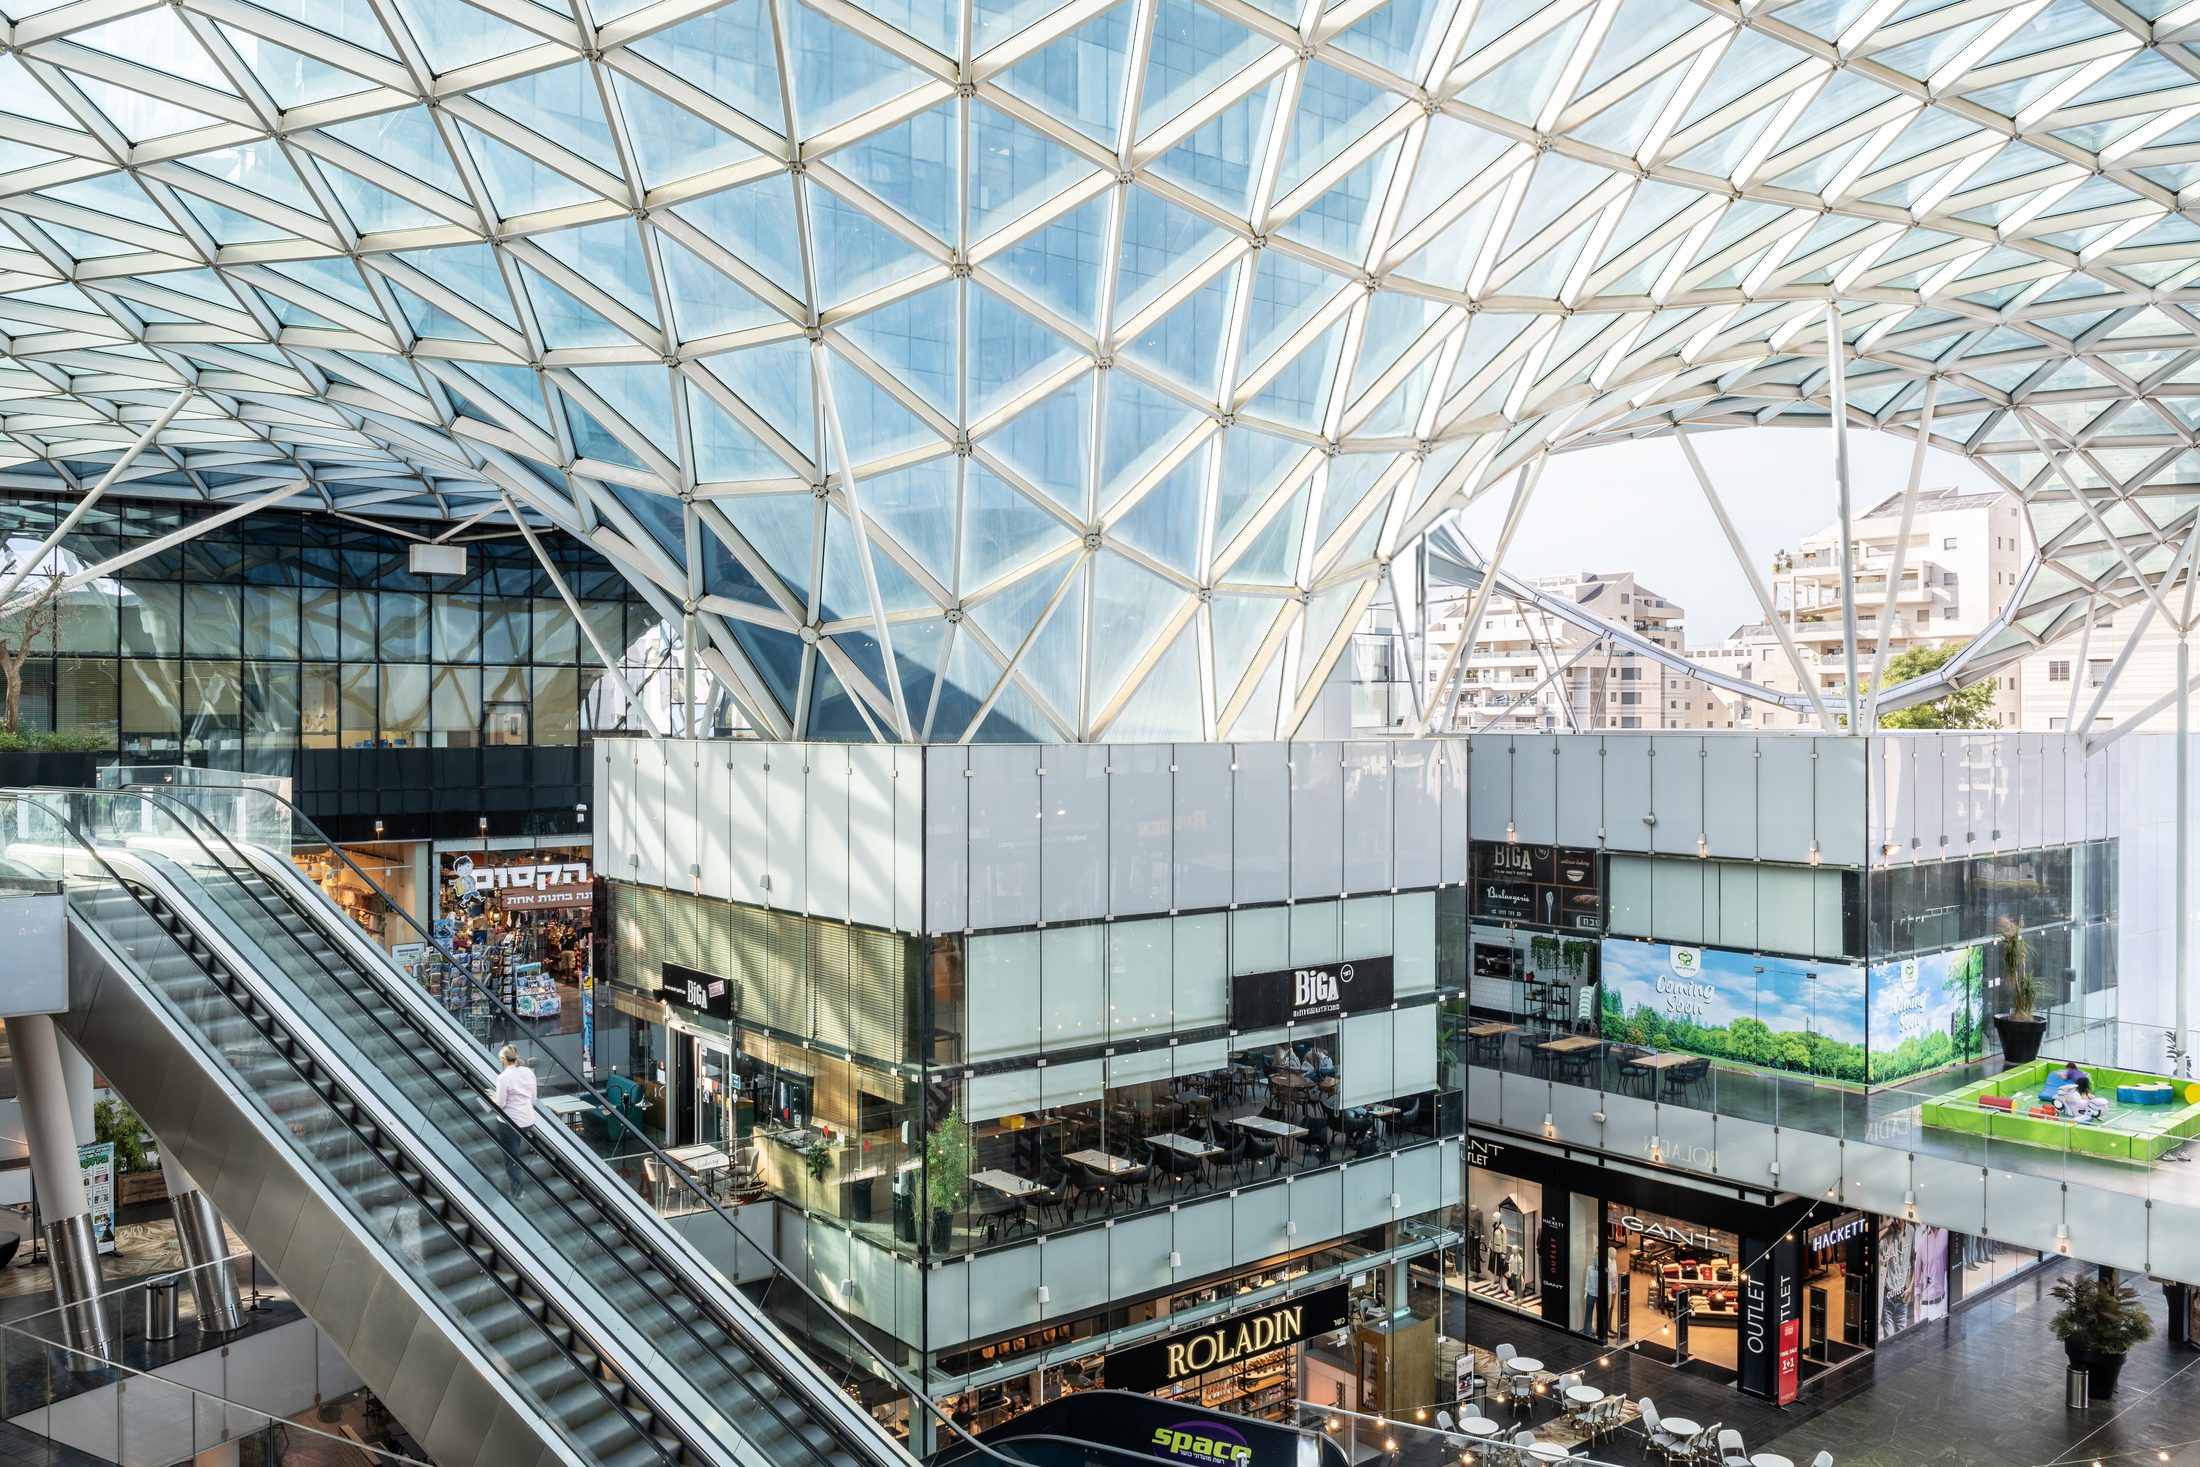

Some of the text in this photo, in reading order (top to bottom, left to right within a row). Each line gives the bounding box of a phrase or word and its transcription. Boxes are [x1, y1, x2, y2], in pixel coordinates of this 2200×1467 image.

[1494, 845, 1532, 870] BIGA
[472, 863, 587, 890] הקסום
[507, 896, 535, 905] אחת
[538, 892, 573, 902] בחנות
[1656, 975, 1714, 1004] Coming
[1667, 996, 1702, 1015] Soon
[1467, 1140, 1504, 1156] NT
[1542, 1218, 1565, 1228] HACKETT
[1621, 1216, 1718, 1249] GANT
[1813, 1219, 1865, 1251] HACKETT
[1543, 1280, 1564, 1290] GANT
[1780, 1275, 1790, 1324] TLET
[1747, 1274, 1764, 1354] OUTLET
[1166, 1306, 1303, 1379] ROLADIN
[1782, 1357, 1795, 1370] 1+1
[1152, 1428, 1252, 1464] space
